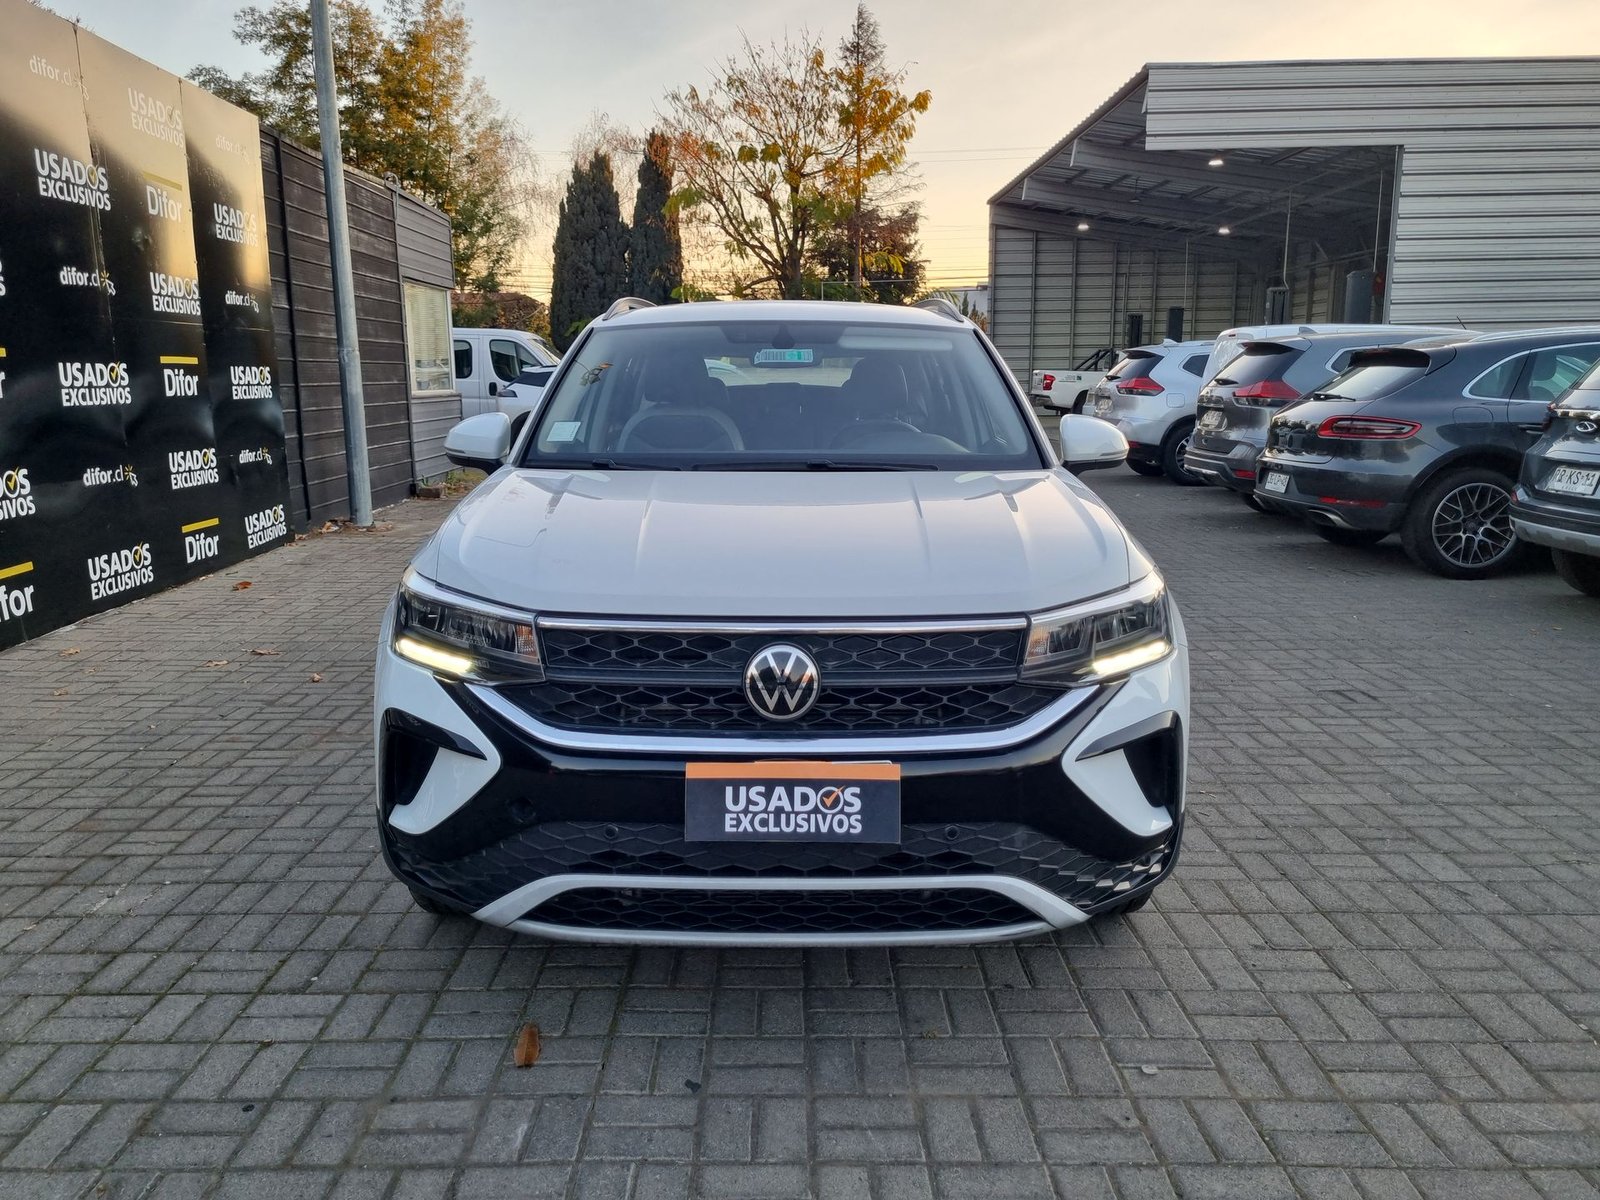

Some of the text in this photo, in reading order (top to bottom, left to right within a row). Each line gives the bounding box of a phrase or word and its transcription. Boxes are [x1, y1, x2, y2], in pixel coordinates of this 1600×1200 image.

[29, 56, 72, 86] difor.cl
[128, 88, 182, 130] USADOS
[131, 112, 184, 147] EXCLUSIVOS
[34, 149, 108, 190] USADOS
[38, 177, 111, 211] EXCLUSIVOS
[147, 185, 182, 222] Difor
[214, 203, 256, 231] USADOS
[215, 223, 258, 246] EXCLUSIVOS
[60, 266, 100, 287] difor.cl
[150, 272, 199, 299] USADOS
[152, 296, 200, 315] EXCLUSIVOS
[225, 290, 250, 306] difor.cl
[58, 362, 129, 387] USADOS
[164, 368, 199, 397] Difor
[230, 366, 271, 385] USADOS
[61, 387, 131, 406] EXCLUSIVOS
[232, 385, 272, 399] EXCLUSIVOS
[169, 448, 216, 473] USADOS
[239, 448, 264, 464] difor.cl
[83, 465, 124, 487] difor.cl
[171, 469, 219, 490] EXCLUSIVOS
[245, 504, 285, 534] USADOS
[185, 534, 219, 563] Difor
[247, 522, 287, 549] EXCLUSIVOS
[88, 543, 151, 581] USADOS
[91, 566, 154, 600] EXCLUSIVOS
[725, 786, 862, 813] USADOS
[724, 813, 862, 833] EXCLUSIVOS
